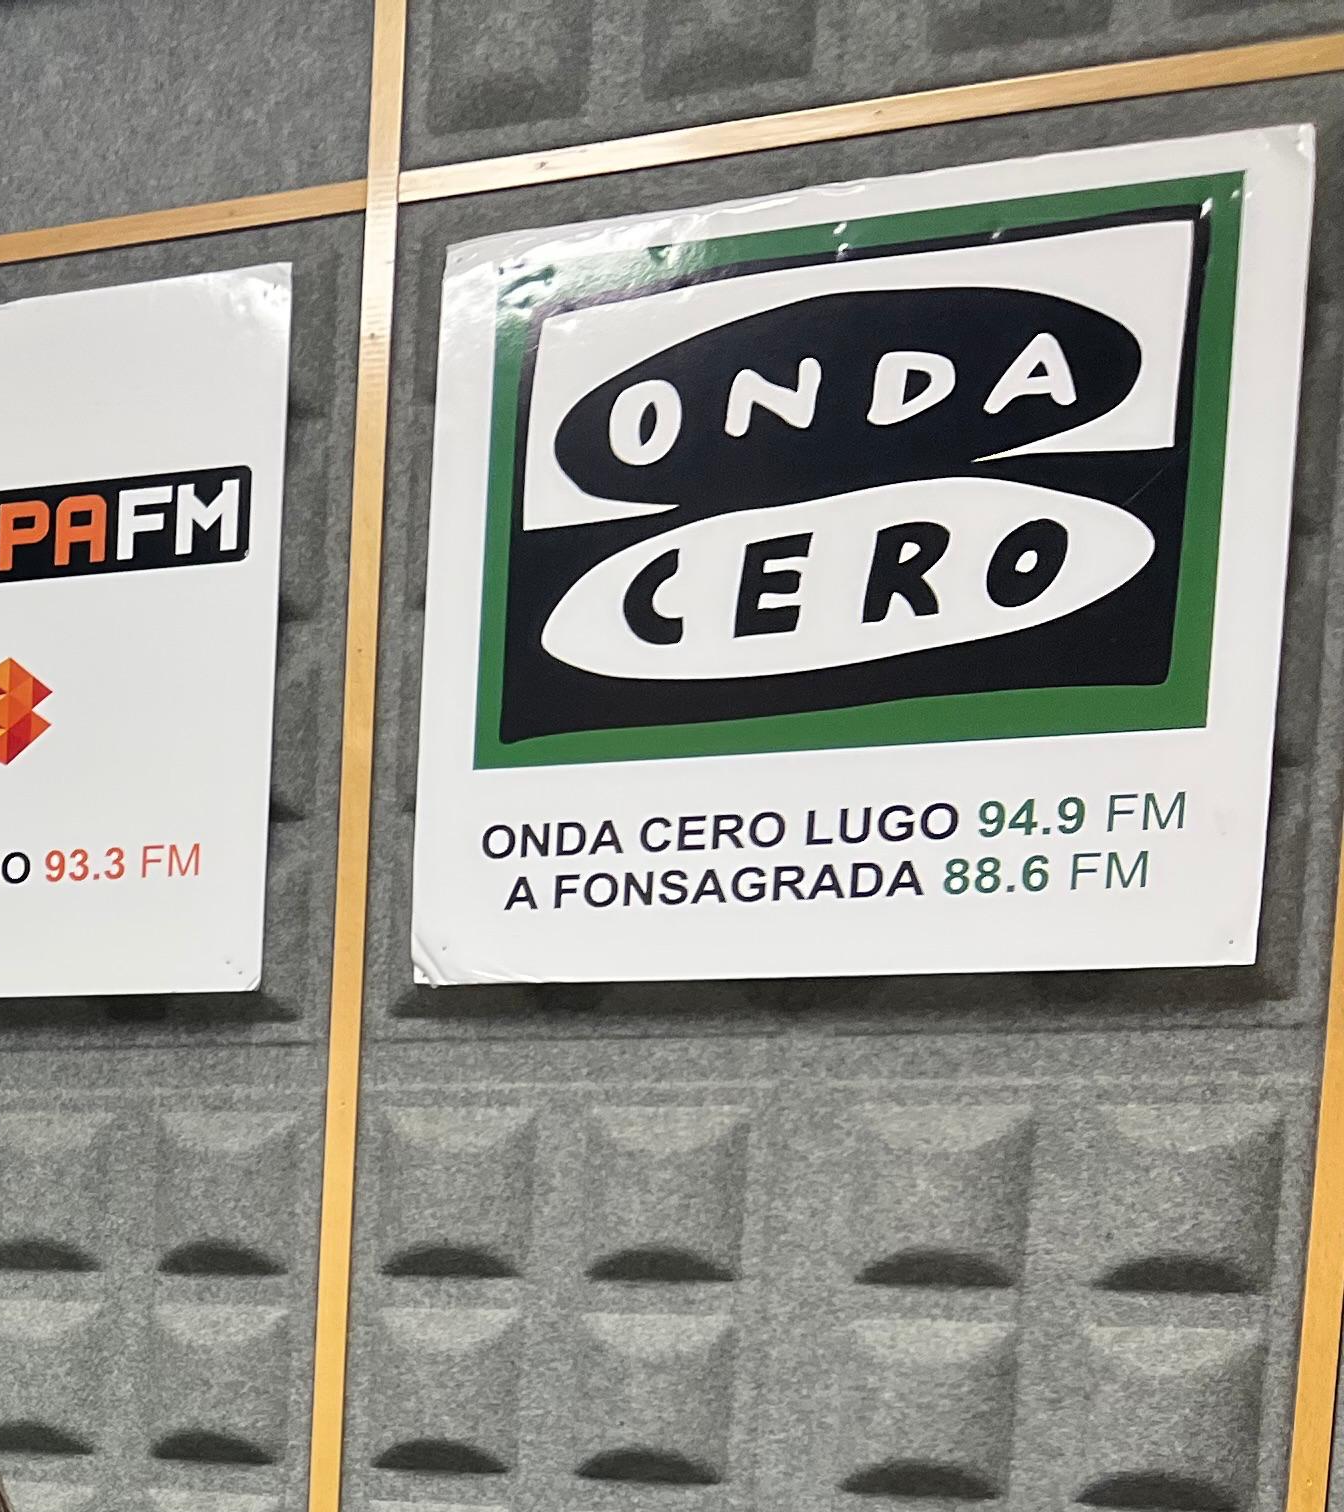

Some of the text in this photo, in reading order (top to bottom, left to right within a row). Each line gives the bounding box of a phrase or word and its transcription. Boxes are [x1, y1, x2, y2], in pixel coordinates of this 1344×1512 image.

[608, 332, 1076, 466] ONDA
[622, 518, 1070, 645] CERO
[483, 792, 1187, 859] ONDA CERO LUGO 94.9 FM
[45, 847, 125, 883] 93.3
[141, 842, 201, 879] FM
[504, 850, 1149, 911] A FONSAGRADA 88.6 FM
